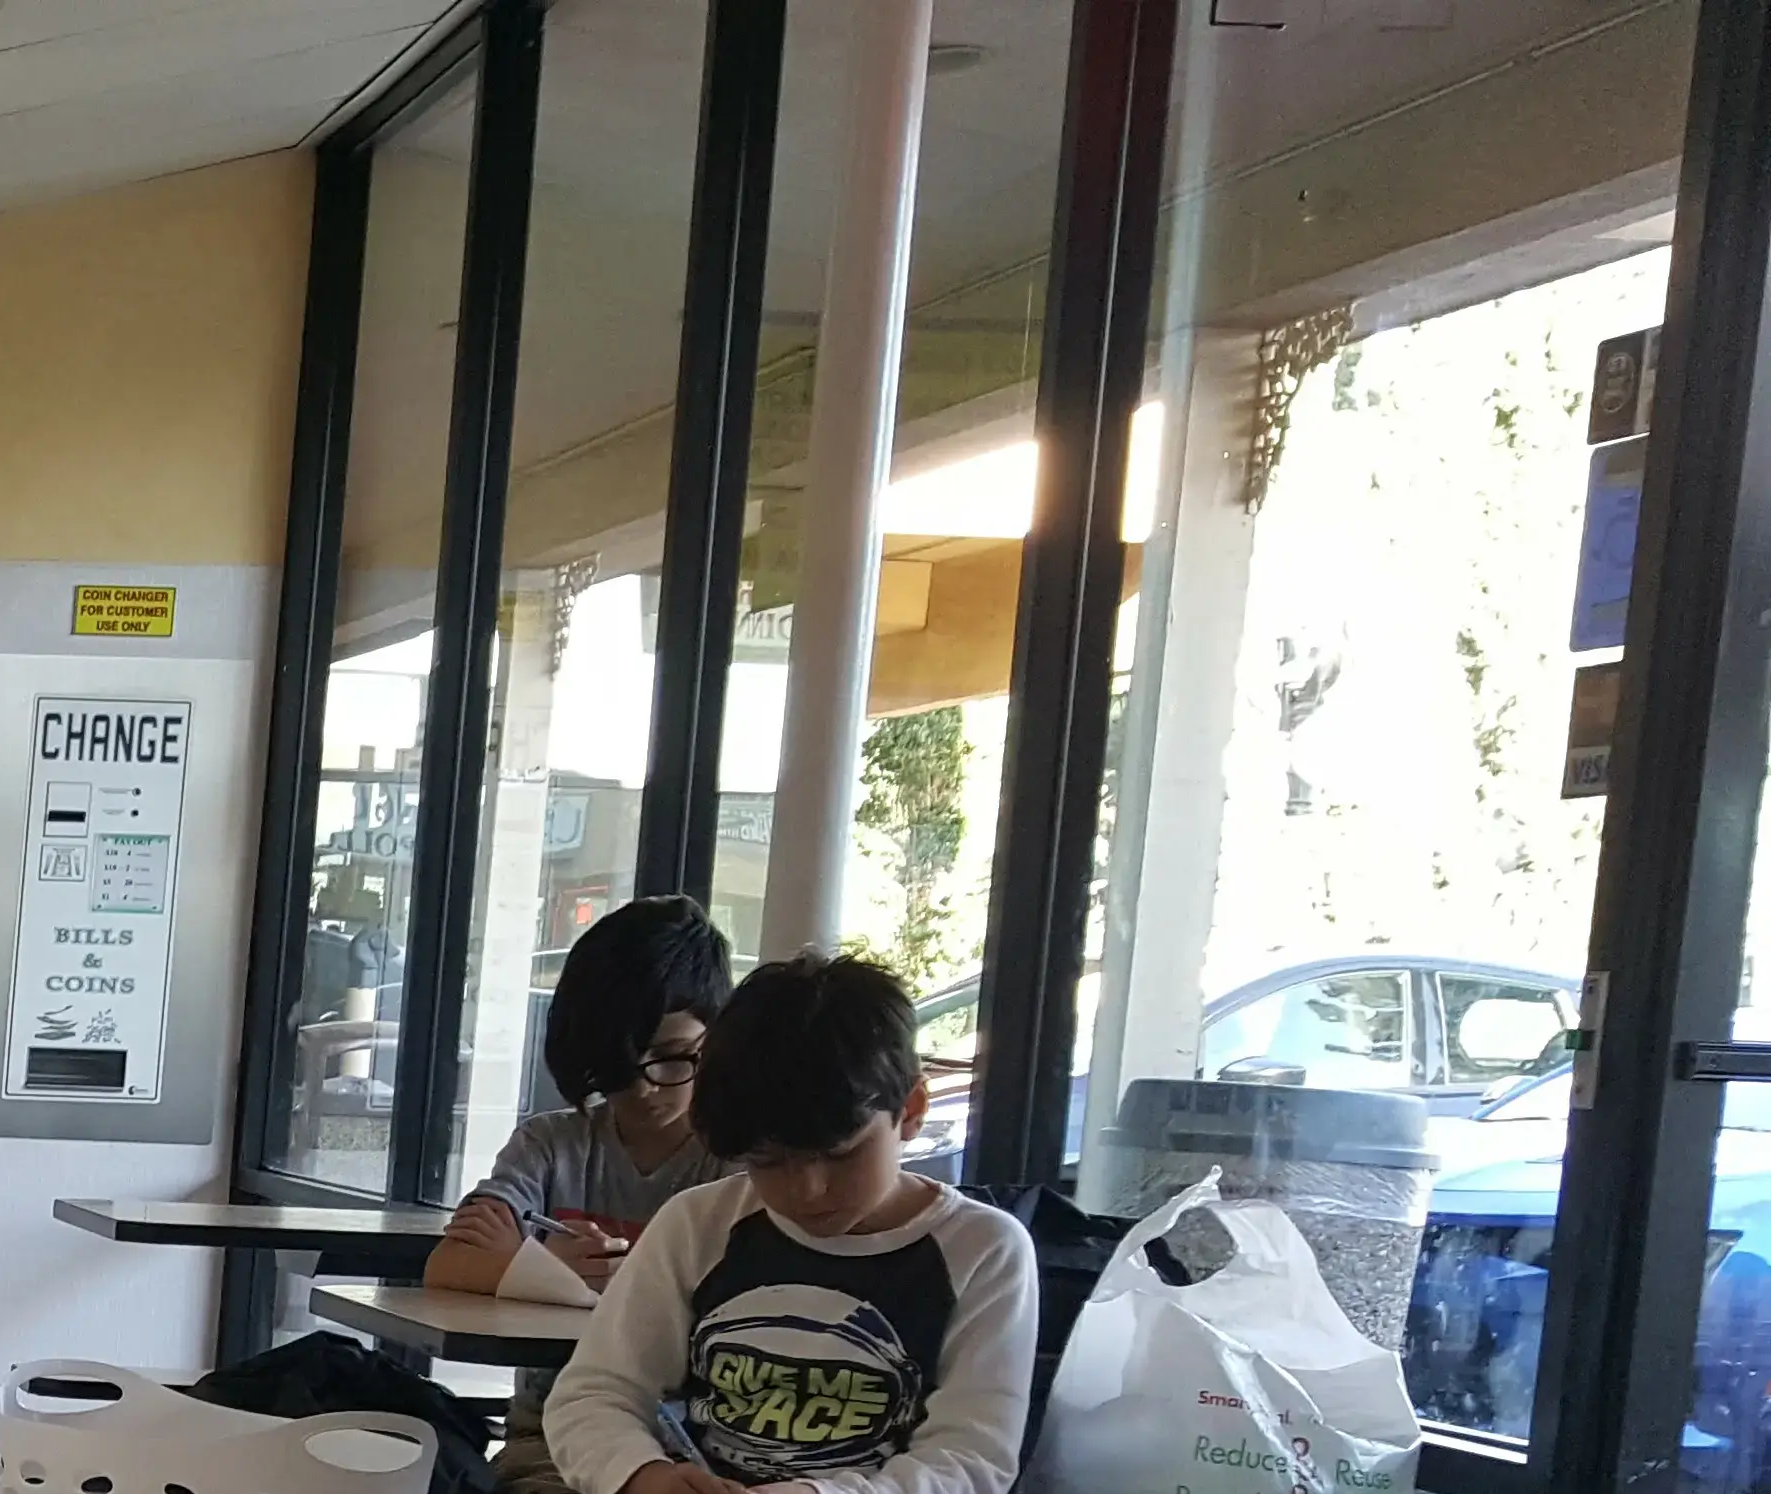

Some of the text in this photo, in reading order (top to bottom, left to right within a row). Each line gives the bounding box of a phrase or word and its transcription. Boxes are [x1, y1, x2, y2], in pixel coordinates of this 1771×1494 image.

[83, 590, 168, 602] COIN CHANGER
[80, 605, 168, 618] FOR CUSTOMER
[96, 620, 151, 632] USE ONLY
[41, 713, 183, 764] CHANGE
[52, 927, 134, 946] BILLS
[82, 953, 103, 968] &
[45, 976, 135, 994] COINS
[710, 1352, 890, 1404] GIVE ME
[1194, 1435, 1287, 1473] Reduce
[1336, 1458, 1393, 1490] Reuse
